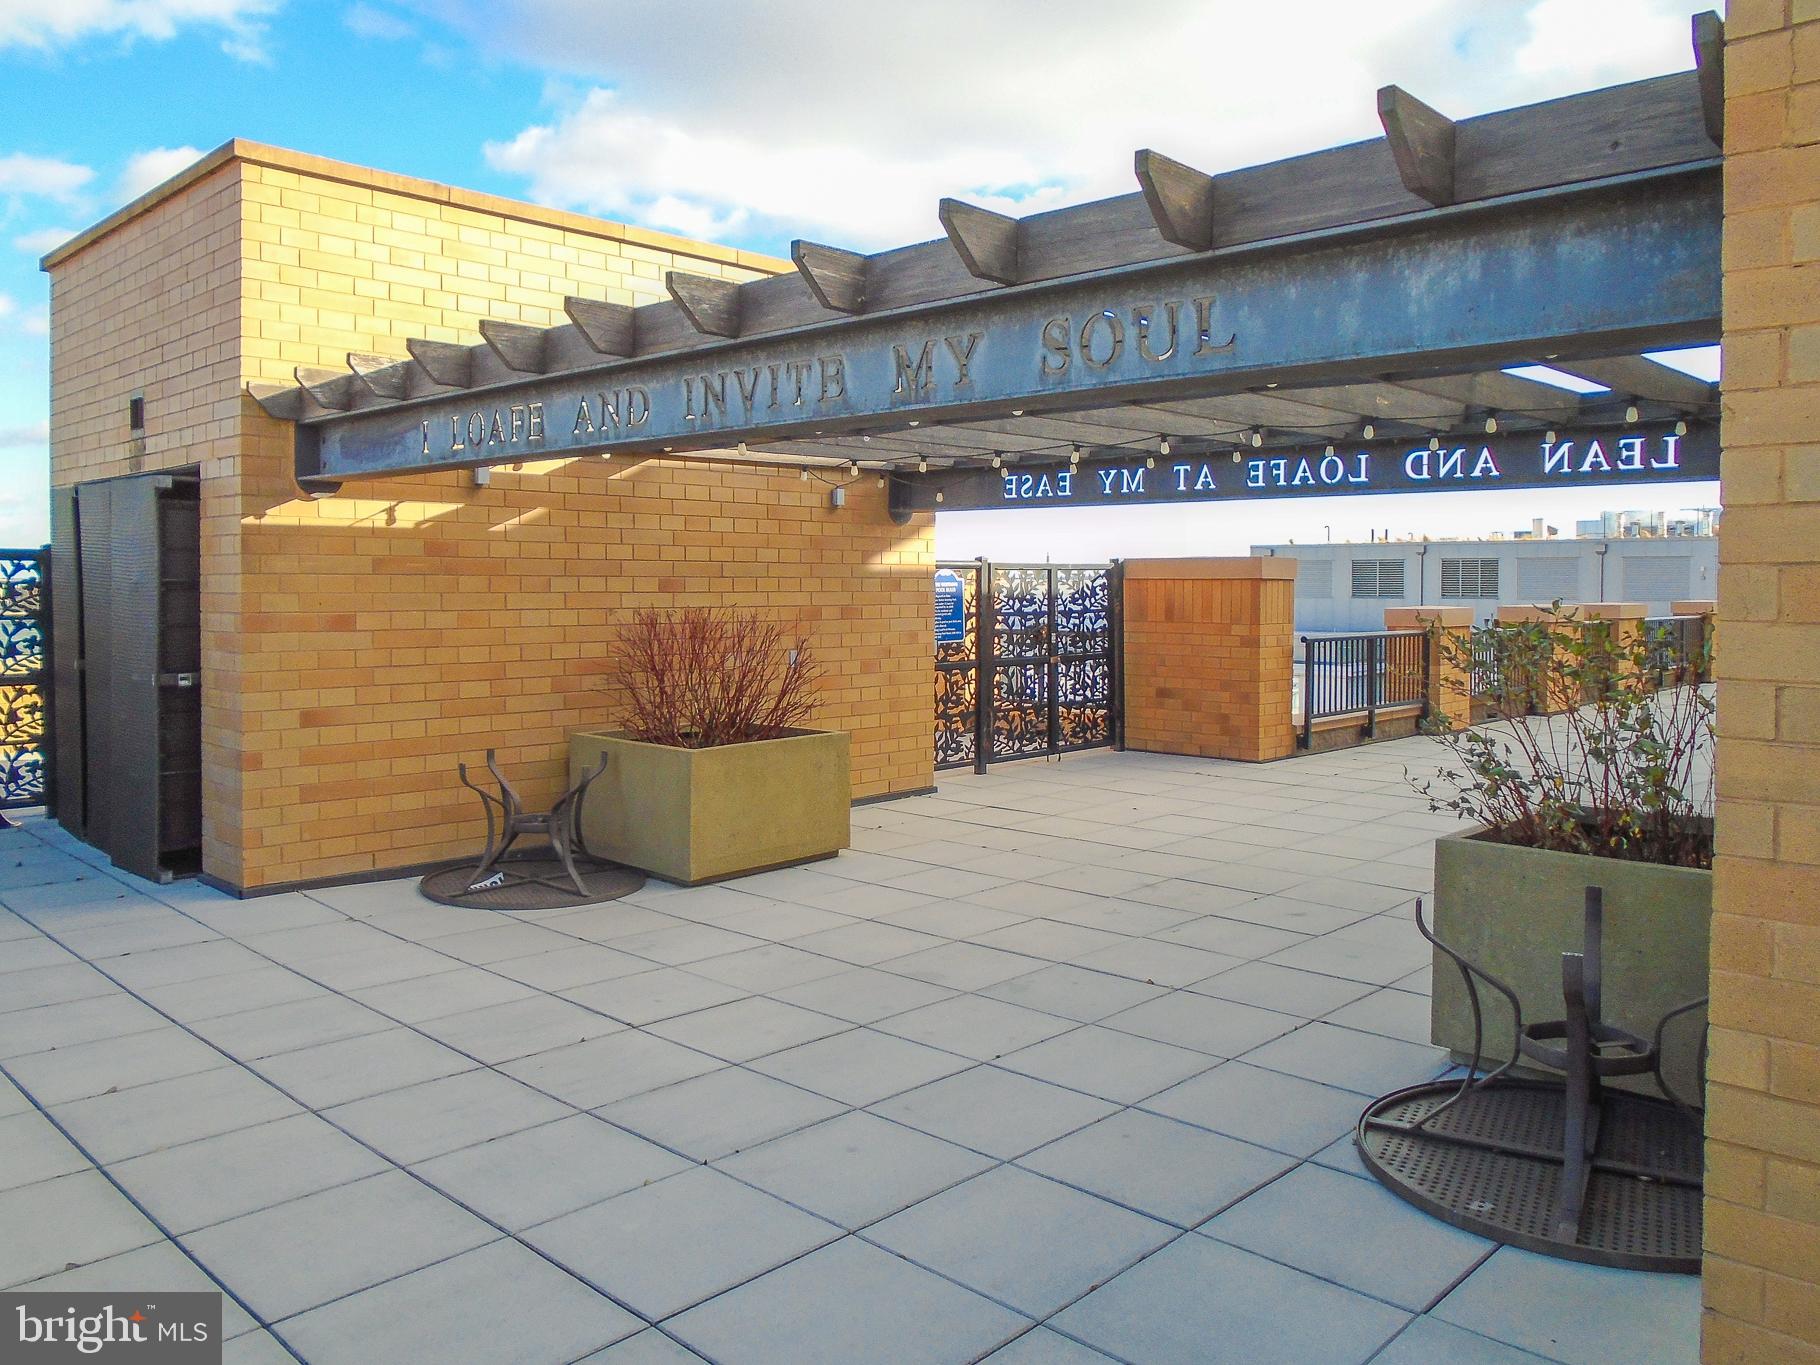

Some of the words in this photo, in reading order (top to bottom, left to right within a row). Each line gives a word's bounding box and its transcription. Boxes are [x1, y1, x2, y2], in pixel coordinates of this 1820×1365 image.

[421, 419, 430, 454] I
[450, 402, 544, 451] LOAFE
[572, 387, 650, 434] AND
[684, 354, 845, 420] INVITE
[892, 332, 985, 394] MY
[1041, 295, 1237, 376] SOUL
